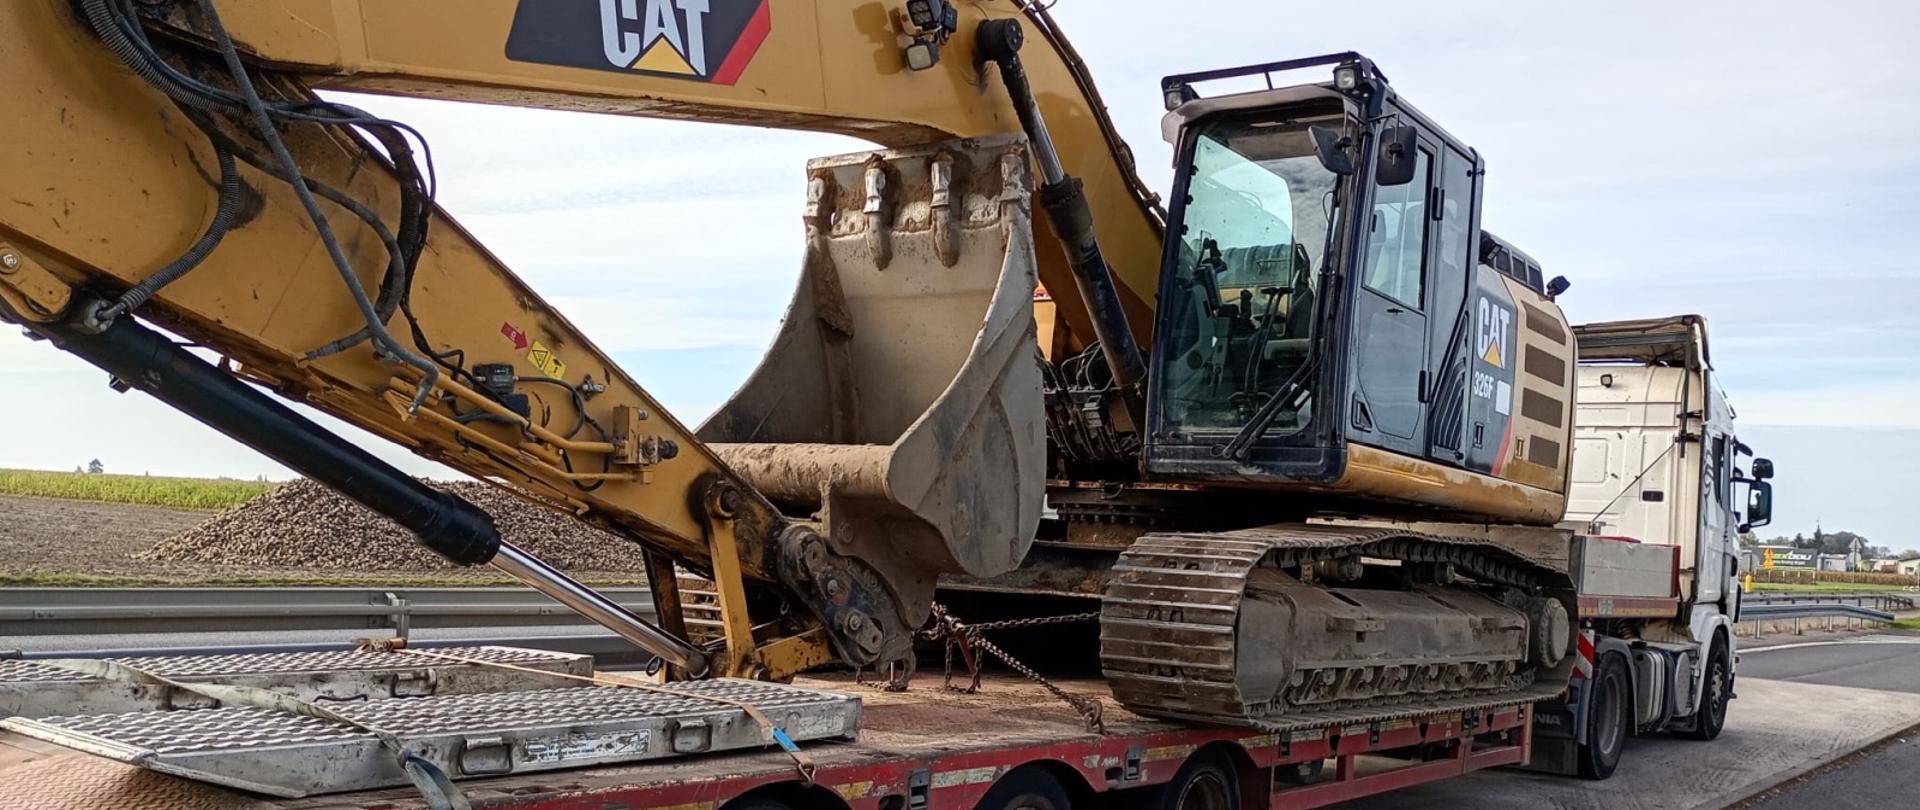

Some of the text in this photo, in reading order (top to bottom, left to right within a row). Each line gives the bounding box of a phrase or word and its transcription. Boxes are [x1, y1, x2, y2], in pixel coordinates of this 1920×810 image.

[600, 0, 709, 76] CAT
[1477, 297, 1510, 369] CAT
[1473, 370, 1494, 399] 326F
